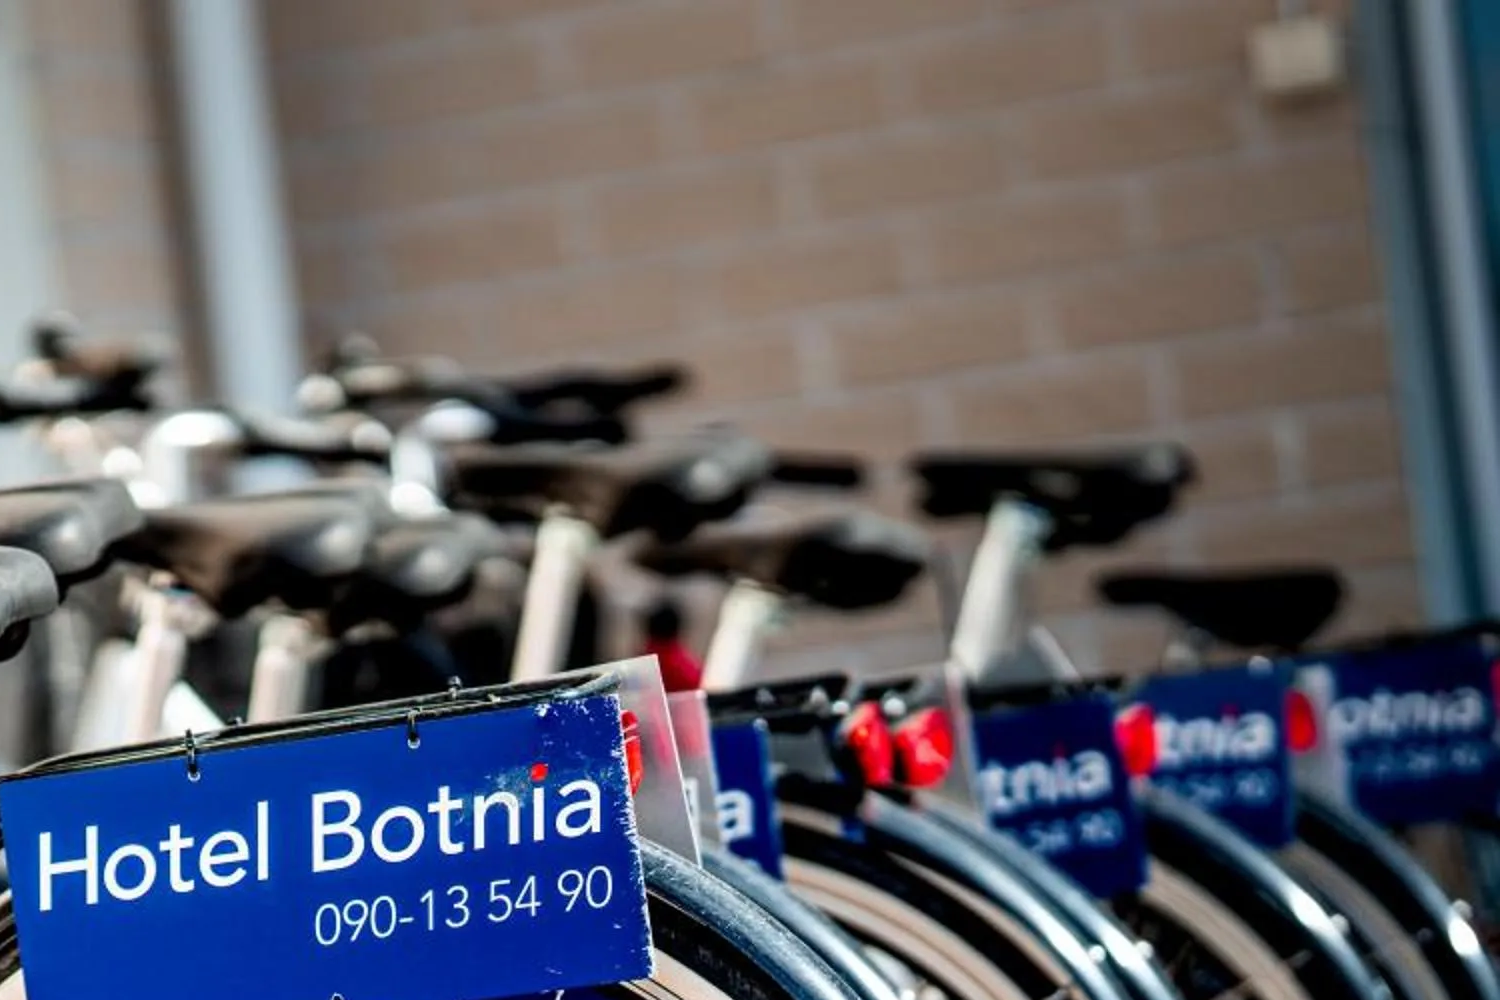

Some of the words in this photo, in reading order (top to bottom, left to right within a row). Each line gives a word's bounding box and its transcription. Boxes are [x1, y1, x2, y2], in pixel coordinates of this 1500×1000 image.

[1153, 708, 1278, 767] tnia
[1329, 686, 1485, 740] otnia
[978, 742, 1113, 813] tnia
[38, 799, 270, 911] Hotel
[310, 762, 603, 873] Botnia
[313, 884, 471, 946] 090-13
[487, 874, 542, 924] 54
[556, 865, 613, 913] 90
